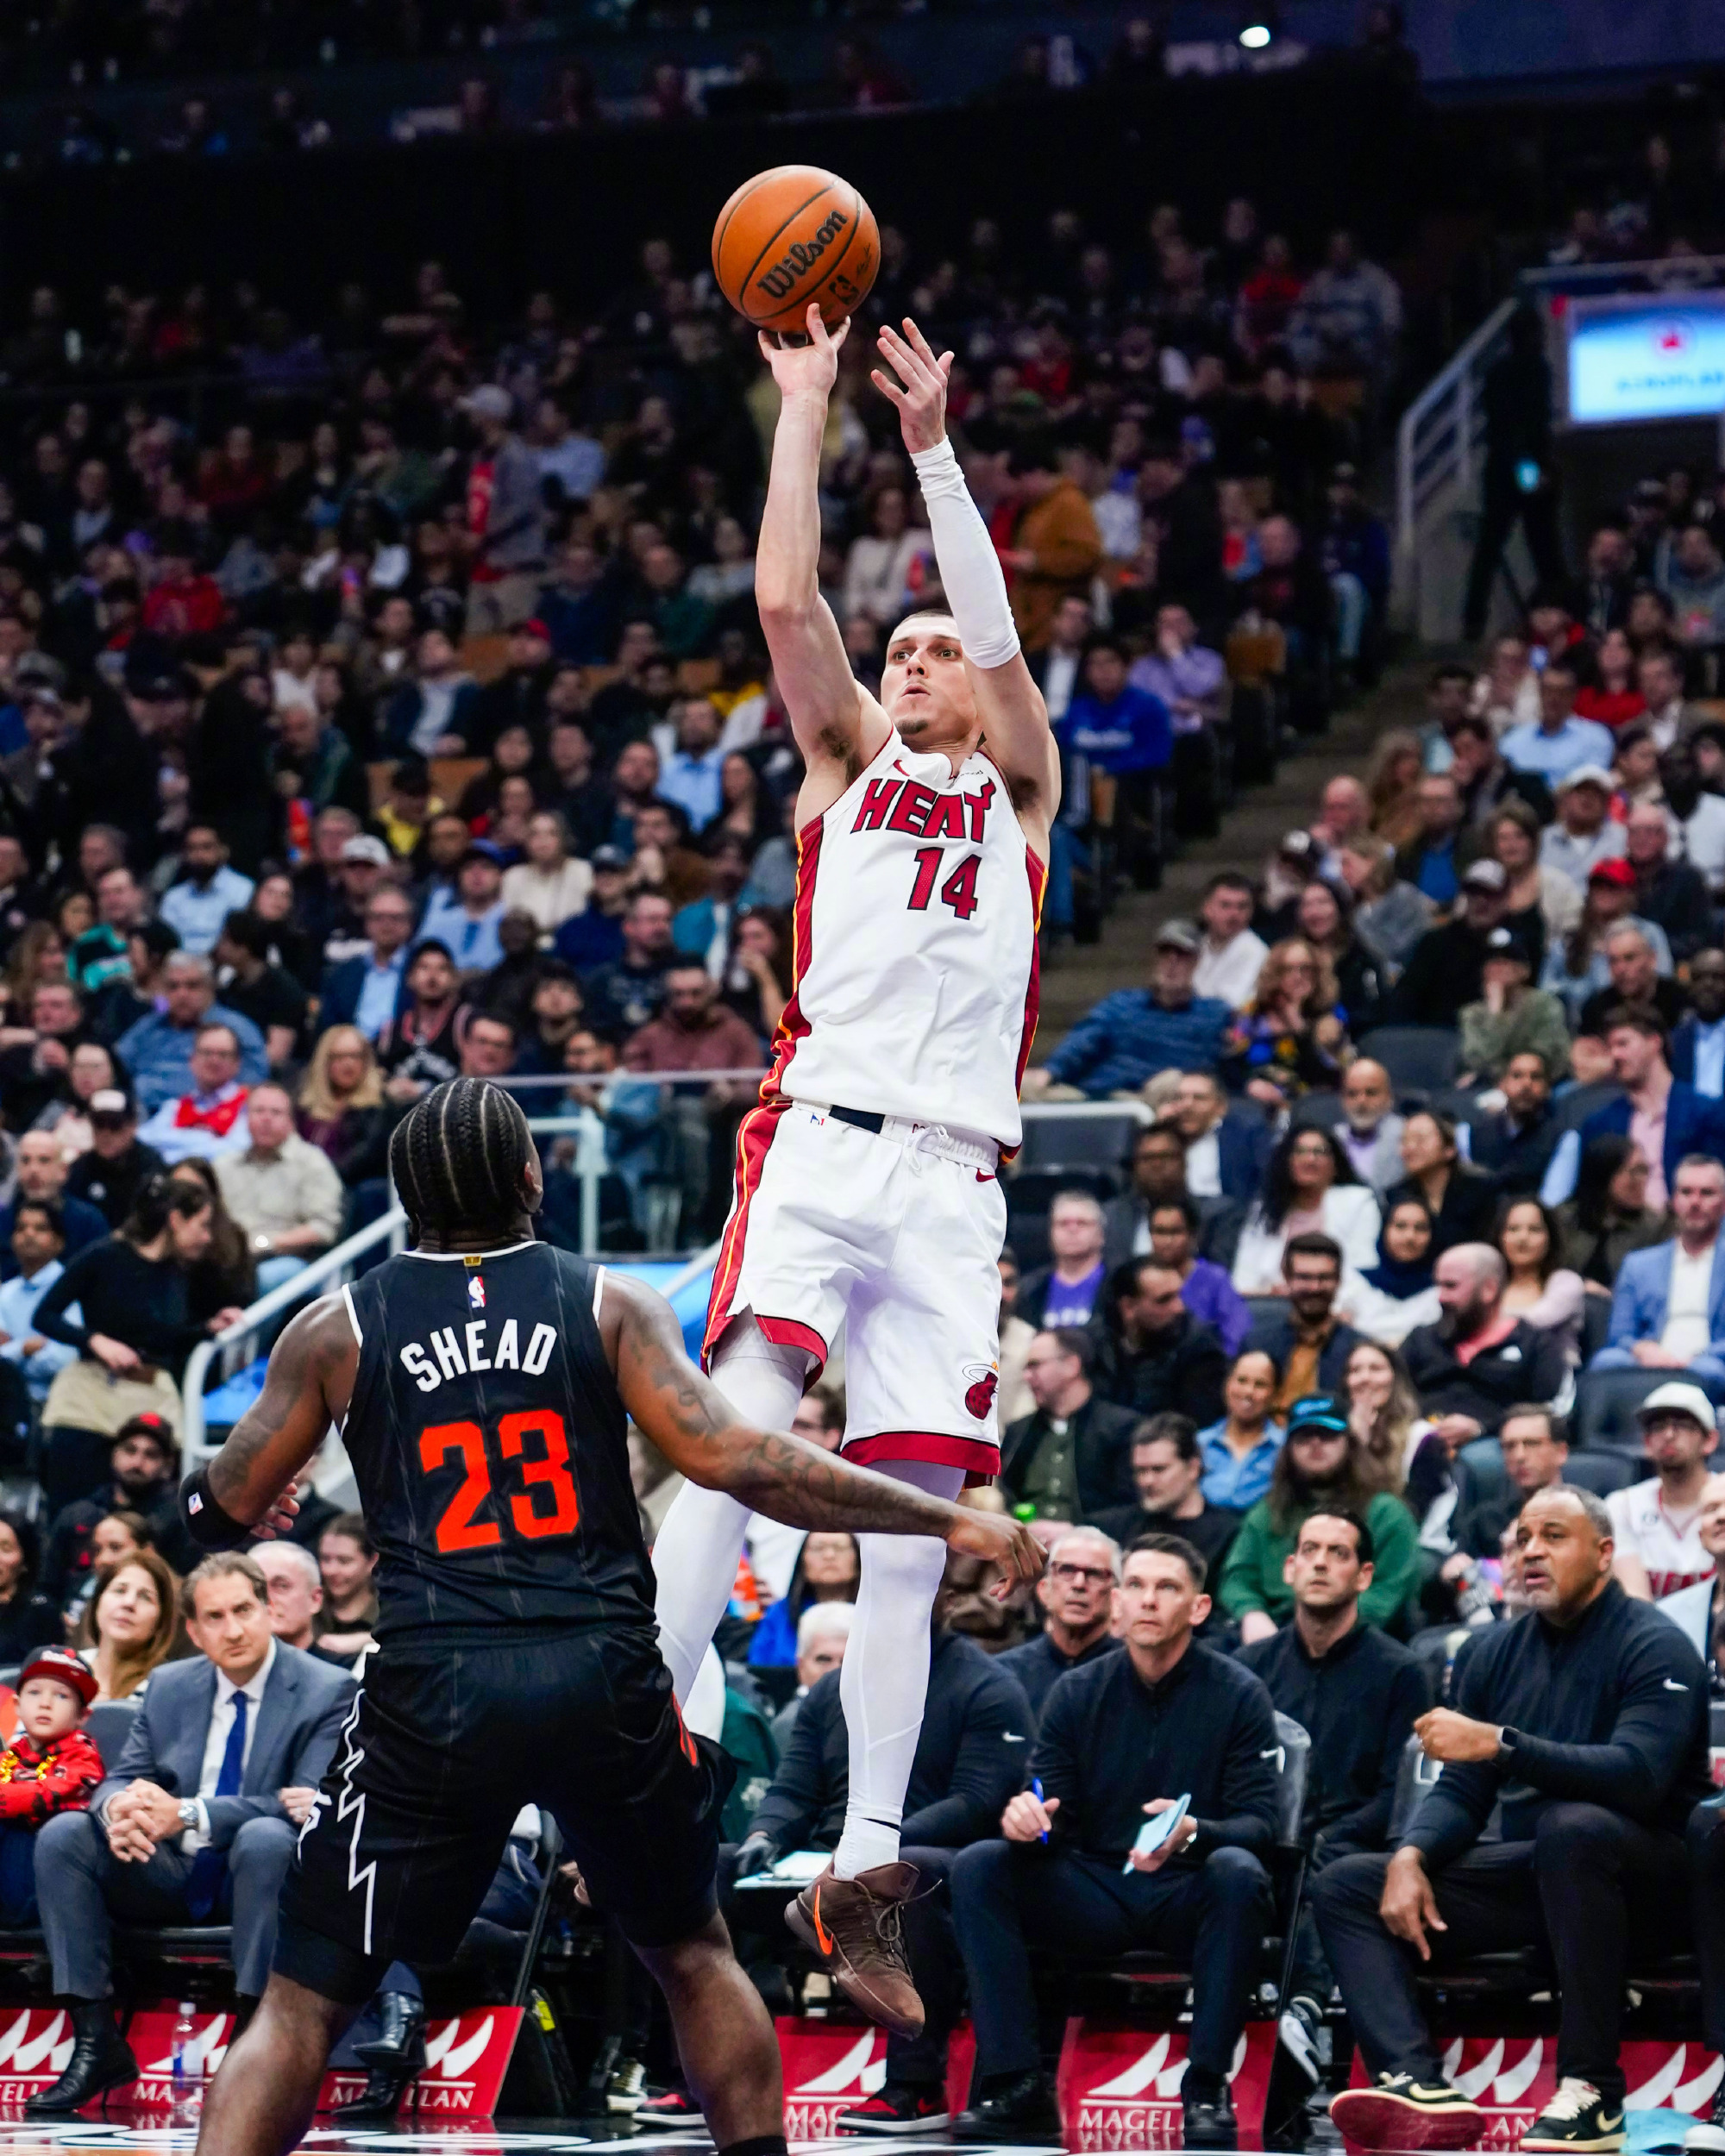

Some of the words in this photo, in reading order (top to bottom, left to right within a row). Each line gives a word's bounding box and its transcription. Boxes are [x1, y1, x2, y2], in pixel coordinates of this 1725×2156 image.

[756, 210, 849, 298] Wilson
[850, 777, 997, 843] HEAT
[906, 847, 982, 920] 14
[399, 1319, 557, 1393] SHEAD
[419, 1409, 580, 1552] 23
[1078, 2108, 1184, 2131] MAGEL
